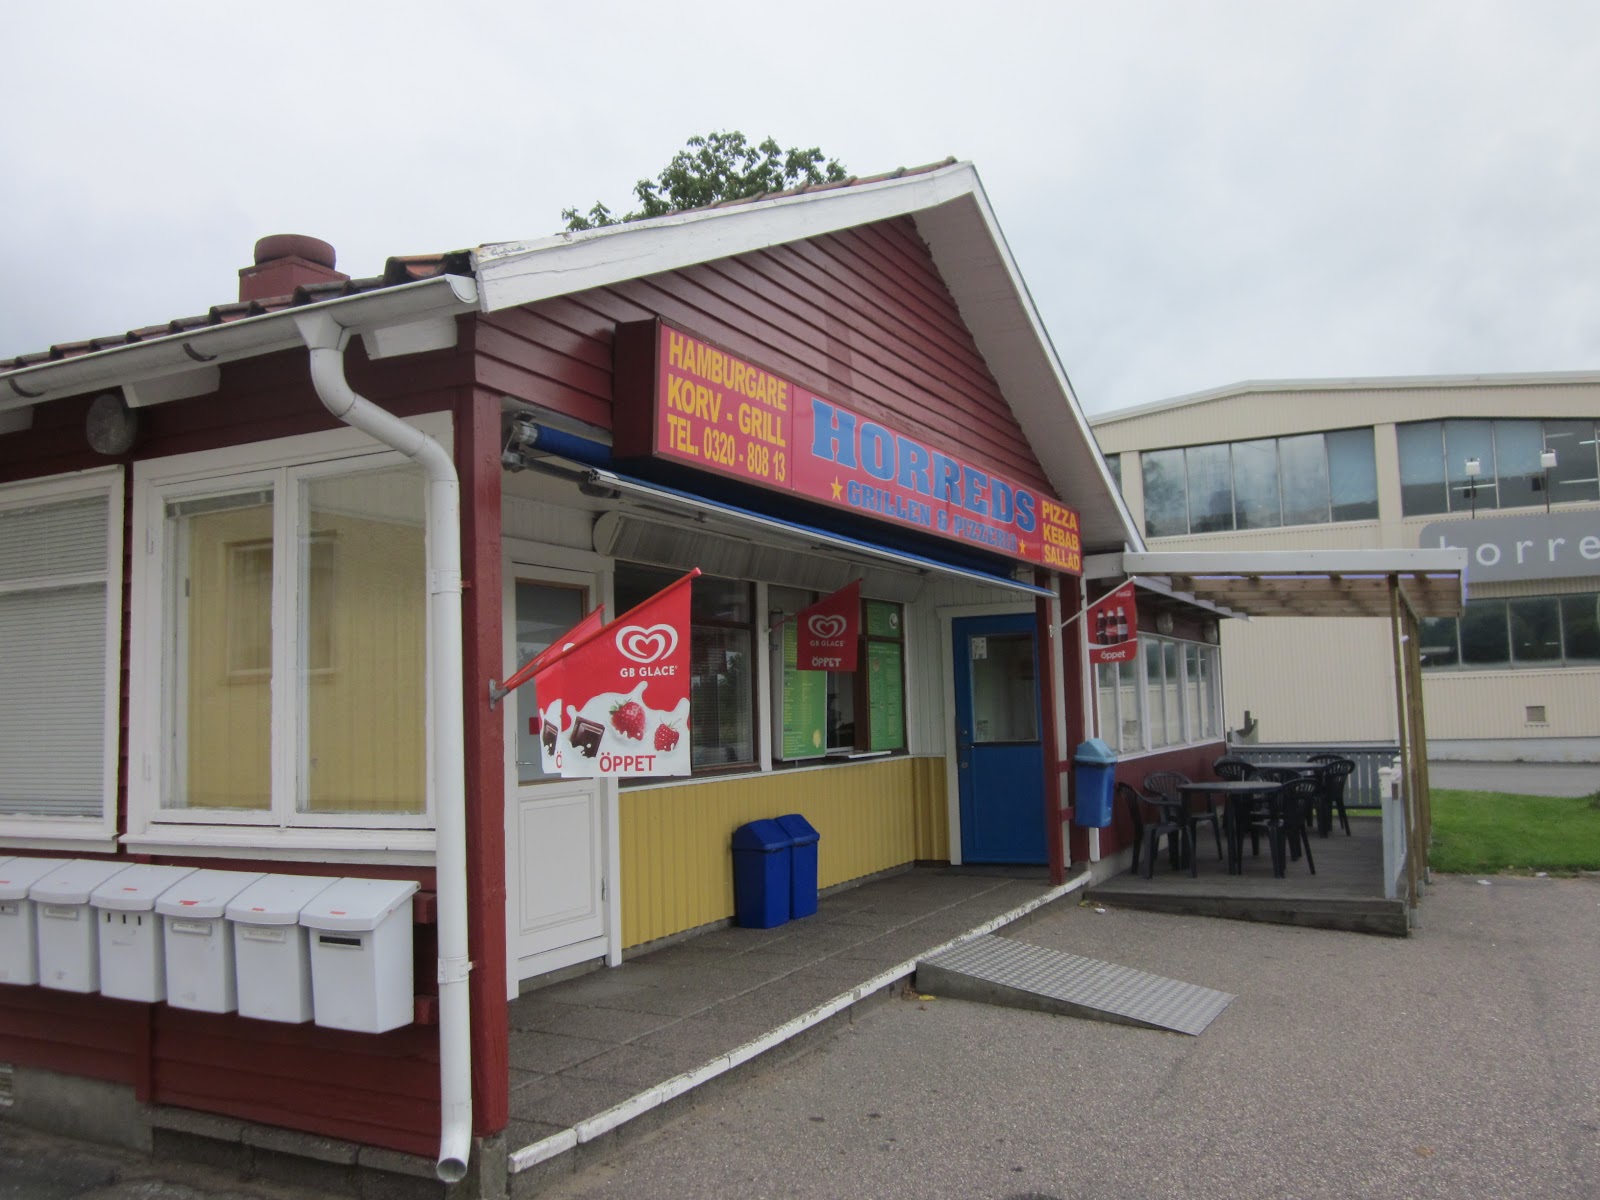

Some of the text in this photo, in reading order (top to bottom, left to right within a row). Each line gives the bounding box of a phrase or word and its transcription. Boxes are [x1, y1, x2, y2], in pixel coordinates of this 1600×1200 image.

[669, 331, 787, 411] HAMBURGARE
[668, 373, 722, 423] KORV
[738, 403, 786, 447] GRILL
[667, 413, 699, 455] TEL.
[812, 397, 1036, 532] HORREDS
[847, 479, 1018, 552] GRILLEN & PIZZERIA
[1042, 500, 1078, 531] PIZZA
[1042, 524, 1079, 551] KEBAB
[1044, 545, 1081, 571] SALLAD
[812, 656, 842, 667] ÖPPET
[1101, 650, 1126, 660] öppet
[620, 665, 675, 678] GB GLACE
[599, 752, 656, 772] ÖPPET
